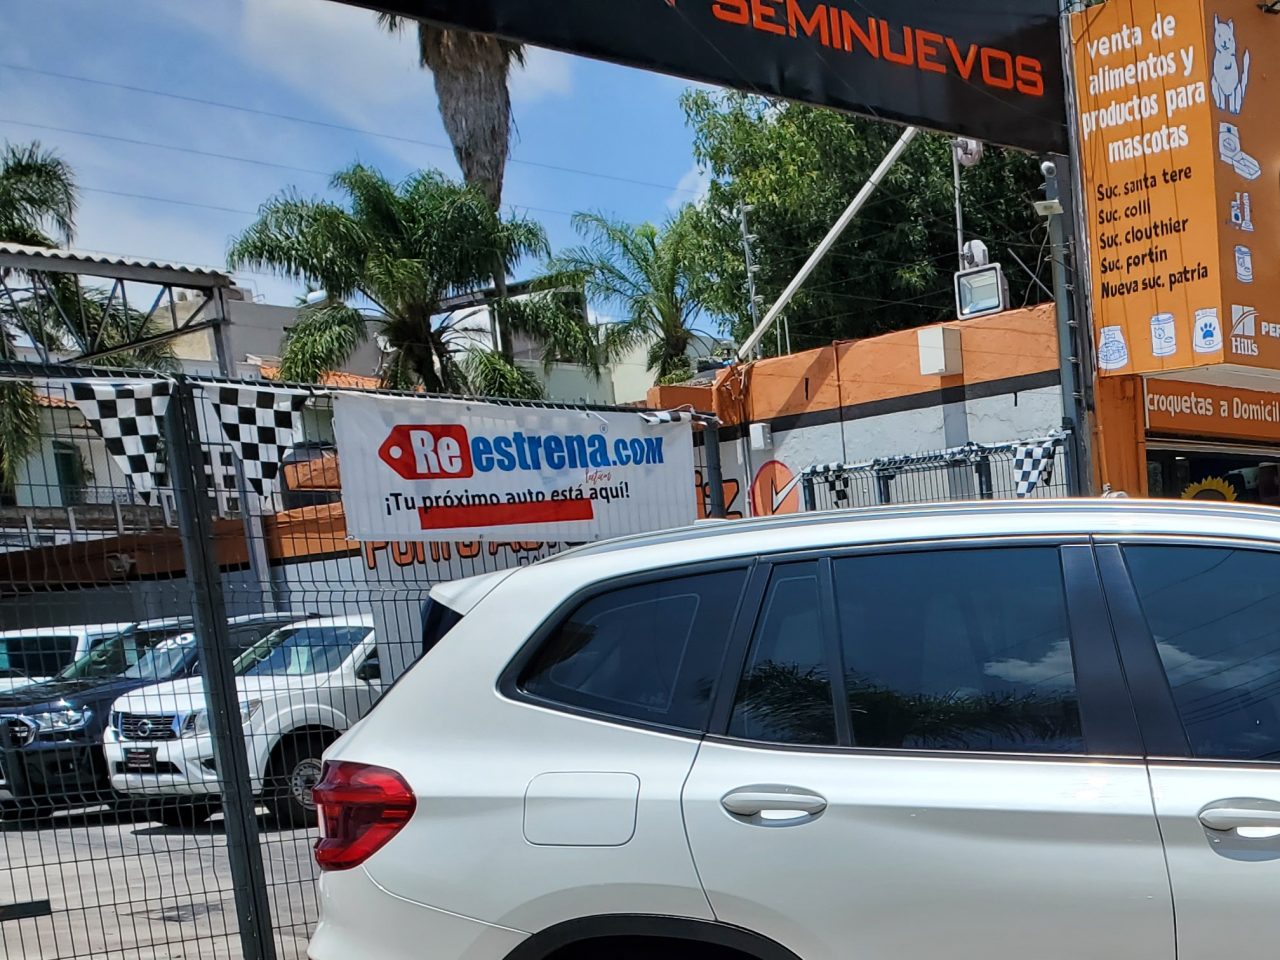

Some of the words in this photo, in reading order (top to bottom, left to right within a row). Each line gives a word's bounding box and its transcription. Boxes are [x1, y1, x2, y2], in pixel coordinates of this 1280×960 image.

[1151, 13, 1176, 40] de
[711, 0, 1044, 96] SEMINUEVOS
[1089, 52, 1177, 95] alimentos
[1180, 46, 1194, 77] y
[1082, 93, 1158, 141] productos
[1166, 81, 1206, 118] para
[1109, 124, 1189, 163] mascotas
[1097, 184, 1121, 201] Suc.
[1124, 173, 1157, 195] santa
[1162, 166, 1192, 184] tere
[1098, 209, 1121, 224] Suc.
[1100, 233, 1122, 249] Suc.
[1125, 217, 1188, 244] clouthier
[1101, 257, 1123, 274] Suc.
[1101, 280, 1138, 299] Nueva
[1141, 275, 1165, 290] suc.
[1169, 262, 1208, 291] patria
[1231, 337, 1259, 356] Hill's
[1220, 399, 1228, 417] a
[422, 489, 500, 513] próximo
[505, 487, 545, 505] auto
[551, 484, 584, 501] está
